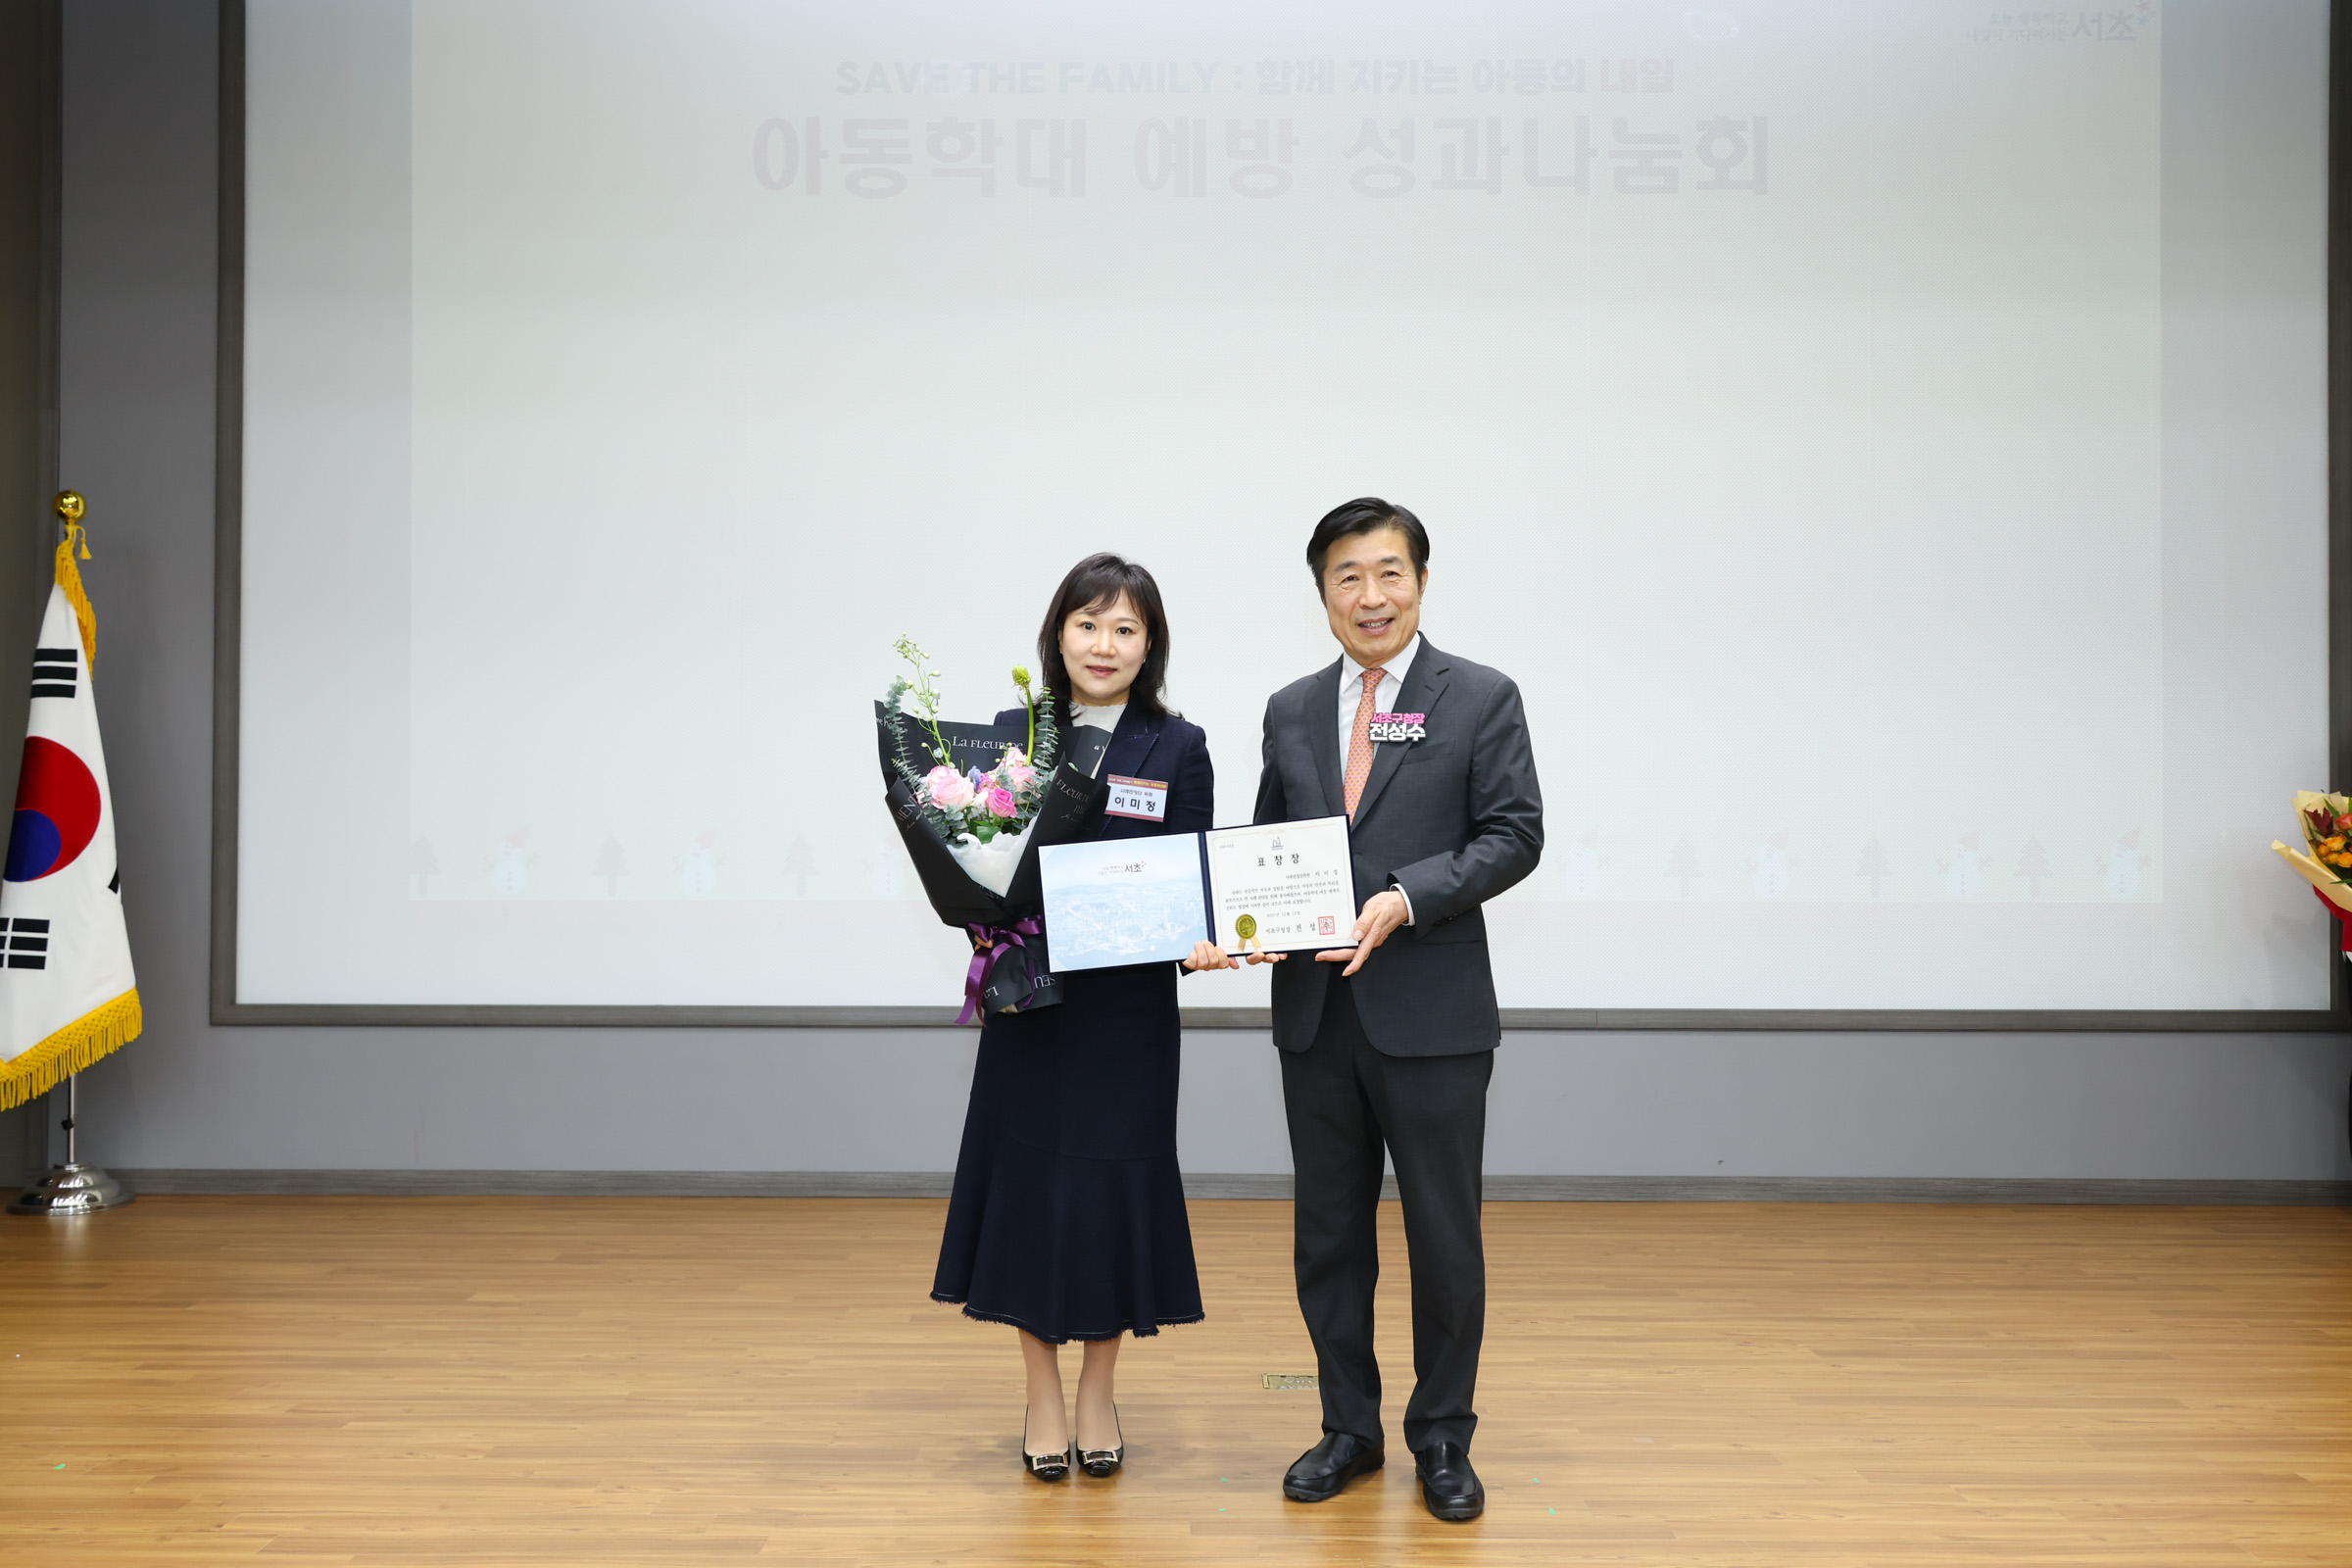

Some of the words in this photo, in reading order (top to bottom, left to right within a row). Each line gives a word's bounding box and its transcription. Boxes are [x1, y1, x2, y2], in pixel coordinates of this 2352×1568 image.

[2071, 8, 2138, 42] 서초
[835, 61, 951, 95] SAVE
[966, 62, 1046, 94] THE
[1057, 62, 1221, 94] FAMILY
[1255, 58, 1335, 95] 함께
[1348, 58, 1459, 95] 지키는
[1472, 58, 1587, 95] 아동의
[1599, 58, 1676, 95] 내일
[752, 116, 1088, 199] 아동학대
[1133, 116, 1301, 200] 예방
[1342, 115, 1771, 199] 성과나눔회
[953, 736, 967, 747] La
[1369, 723, 1426, 742] 전성수
[1124, 862, 1143, 873] 서초
